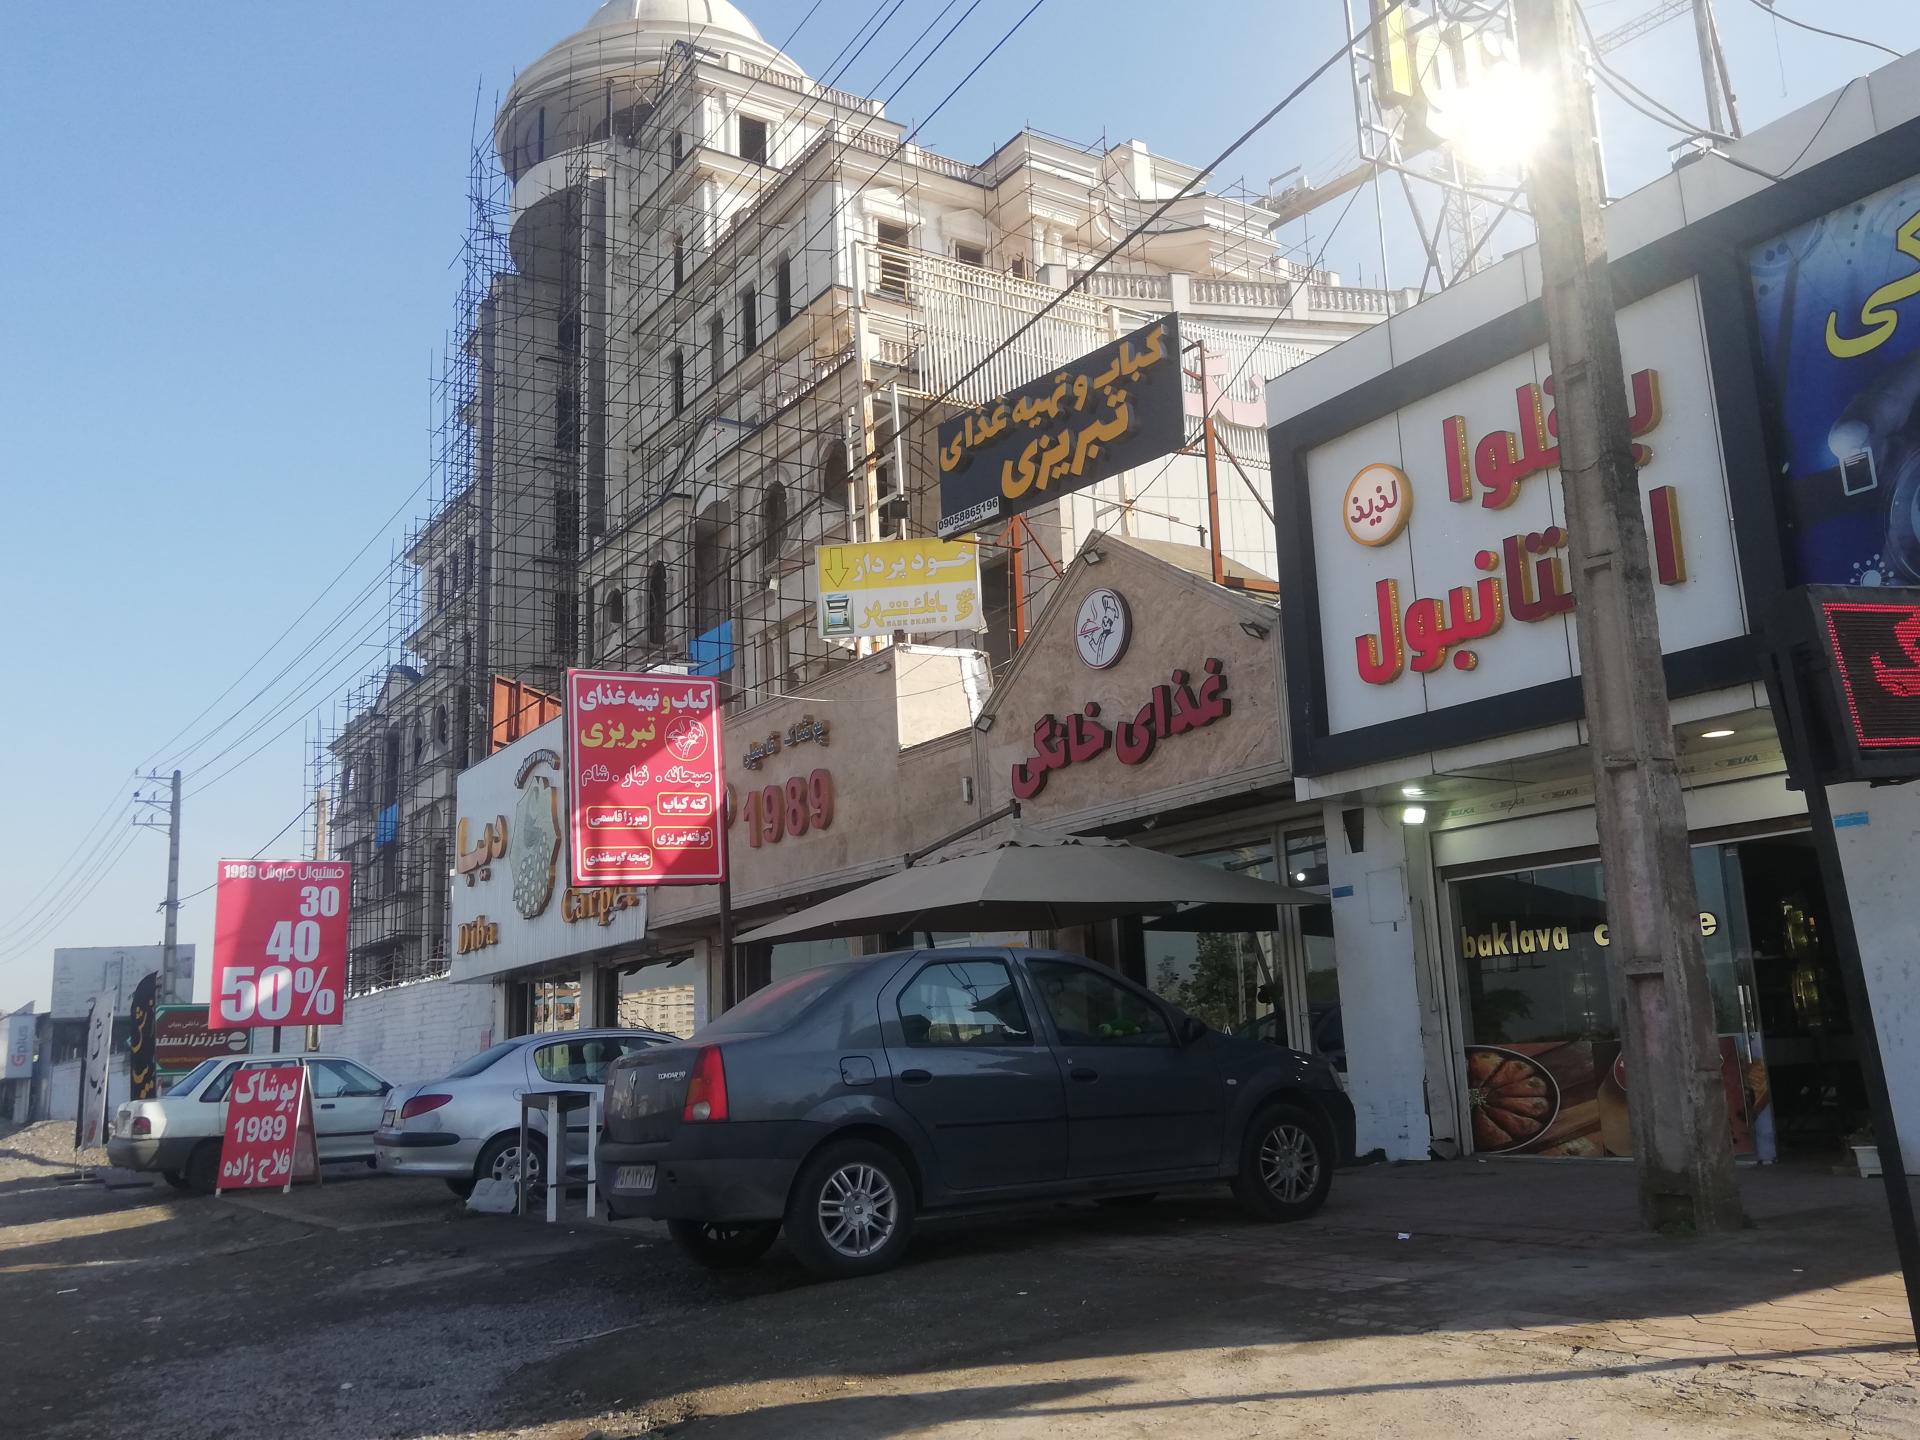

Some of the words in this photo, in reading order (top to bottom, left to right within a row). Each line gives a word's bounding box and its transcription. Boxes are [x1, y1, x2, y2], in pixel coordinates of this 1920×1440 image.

[1094, 324, 1165, 394] کباب
[1013, 371, 1067, 427] تهیه
[1073, 374, 1088, 411] و
[940, 394, 1007, 471] غذای
[1001, 389, 1131, 499] تبریزی
[938, 498, 998, 530] 09058865196
[1350, 480, 1399, 526] لذیذ
[1355, 485, 1687, 685] اتانبول
[579, 684, 626, 711] غذای
[627, 687, 660, 712] تهیه
[660, 695, 670, 714] و
[672, 688, 711, 714] کباب
[1116, 657, 1231, 765] غذای
[580, 716, 657, 749] تبریزی
[1011, 701, 1112, 799] خانگی
[581, 763, 610, 786] شام
[621, 764, 650, 788] نهار
[664, 765, 713, 788] صبحانه
[662, 797, 688, 813] کباب
[689, 796, 708, 811] کته
[743, 768, 833, 848] 1989
[457, 815, 508, 887] دیبا
[300, 885, 340, 918] 30
[265, 920, 321, 963] 40
[457, 915, 499, 954] Diba
[1461, 919, 1569, 959] baklava
[220, 965, 336, 1022] 50%
[235, 1070, 298, 1112] پوشاک
[234, 1115, 288, 1143] 1989
